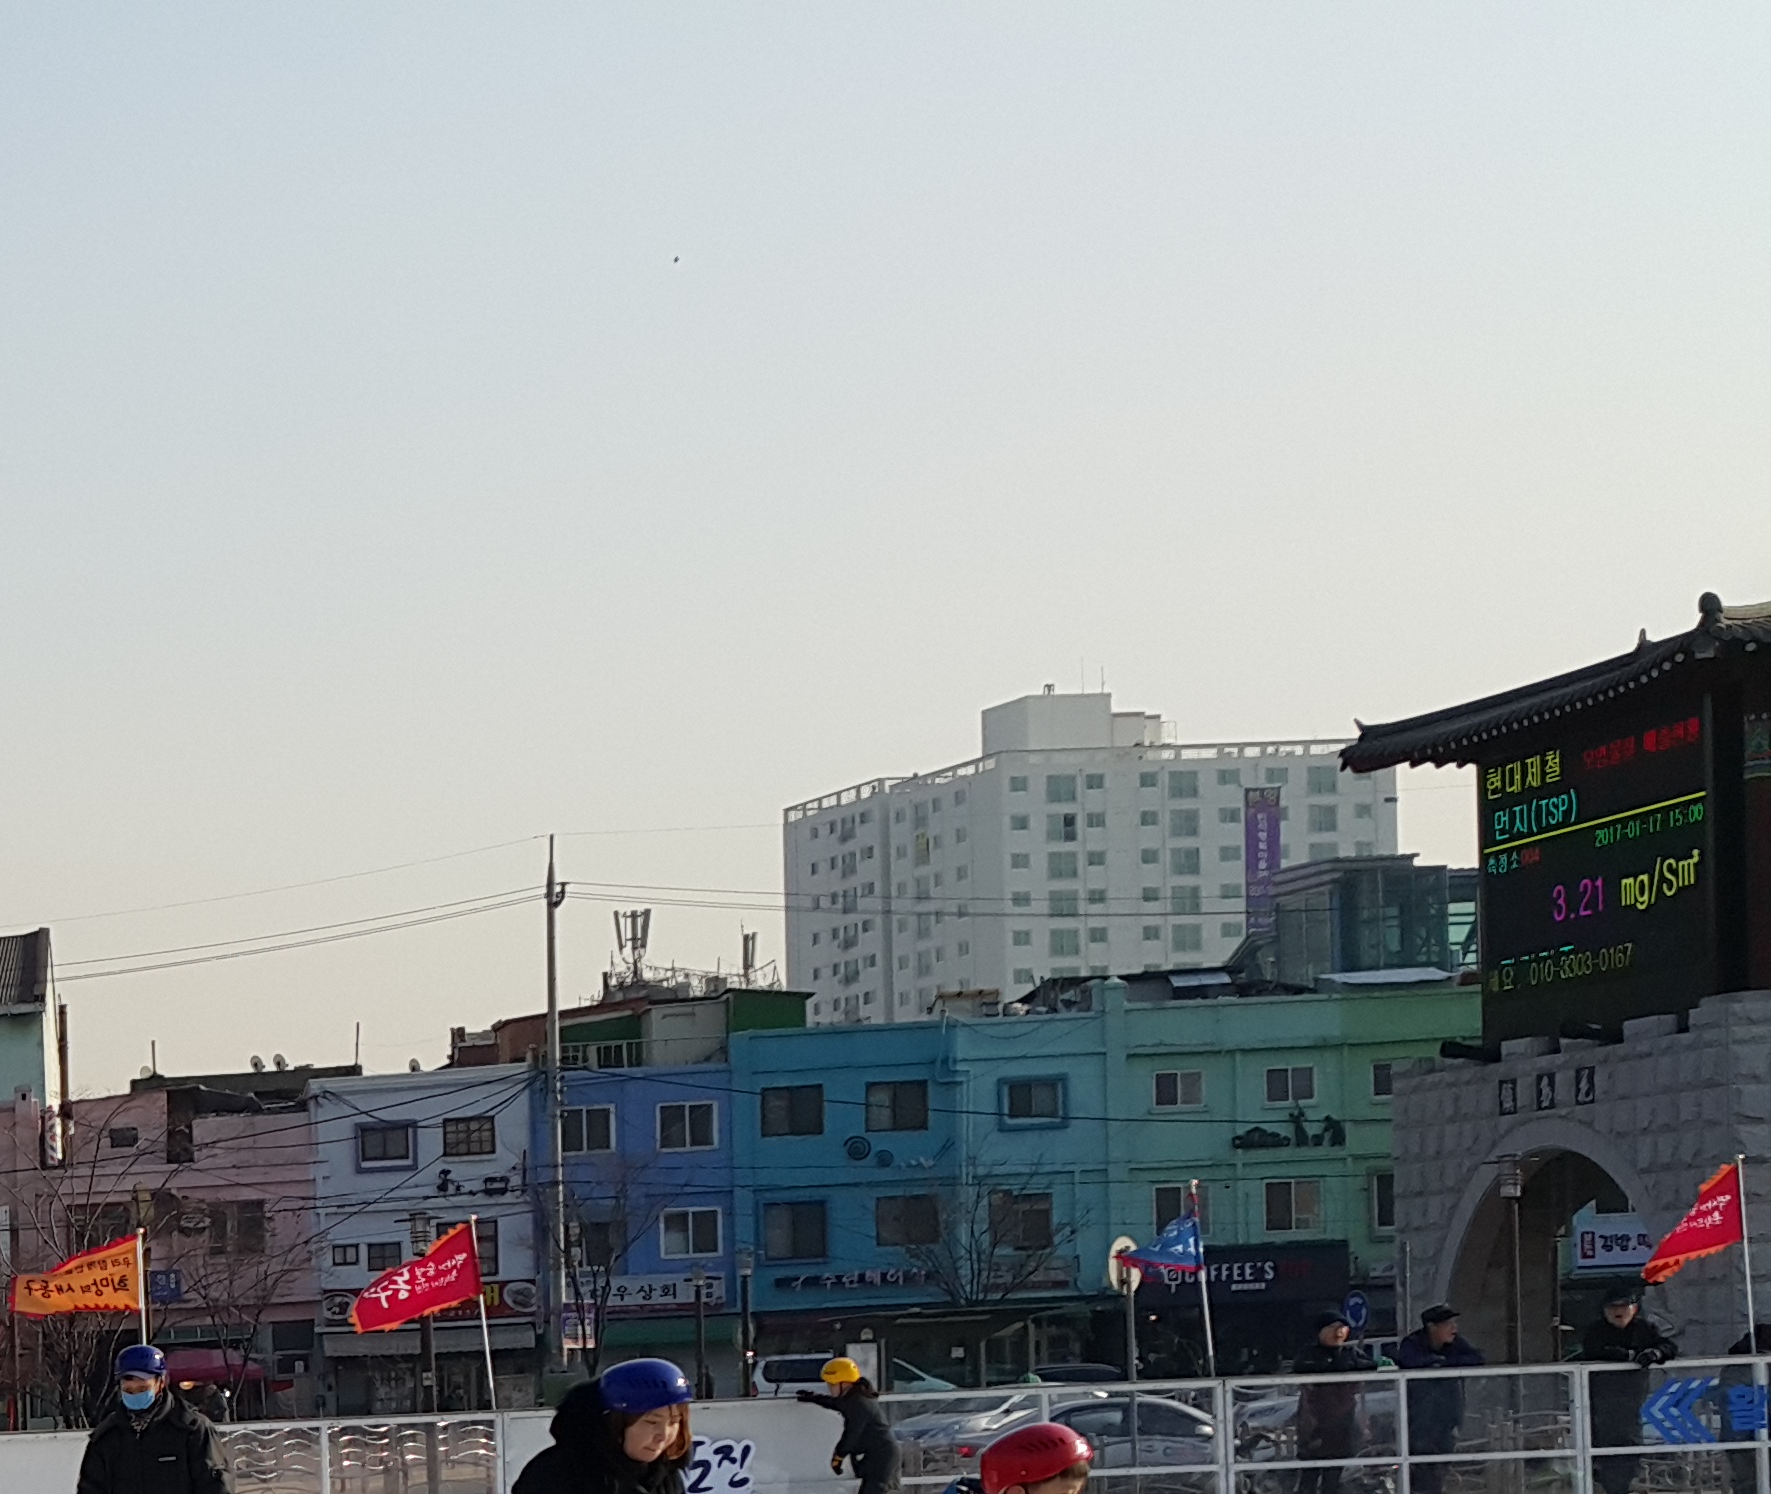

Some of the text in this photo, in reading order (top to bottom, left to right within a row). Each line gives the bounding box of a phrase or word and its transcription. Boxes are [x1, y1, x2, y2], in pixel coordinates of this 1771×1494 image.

[1486, 749, 1562, 800] 현대제철
[1494, 788, 1577, 840] 먼지(TSP)
[1594, 802, 1704, 847] 2017-01-17 15:00
[1552, 876, 1605, 921] 3.21
